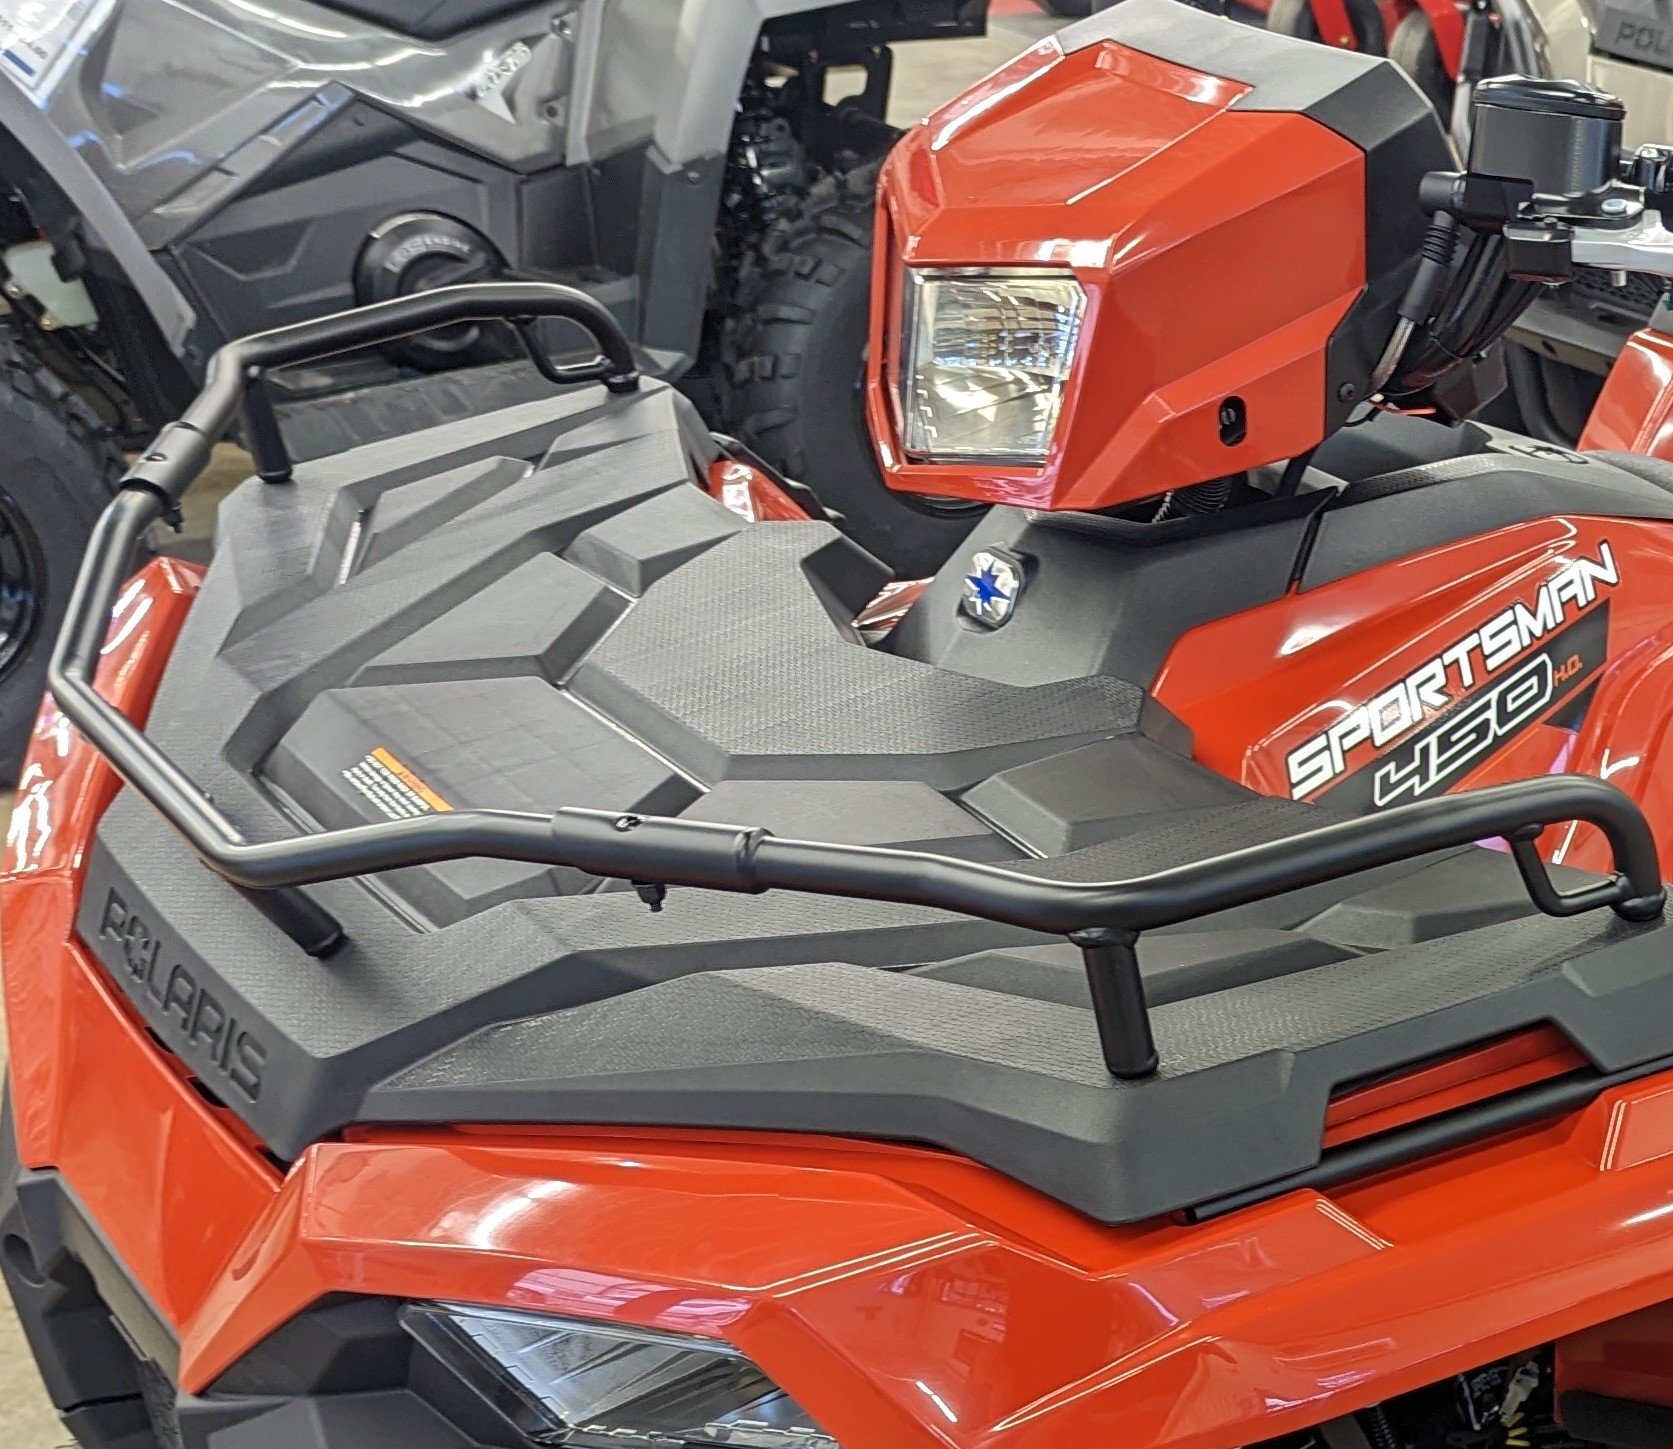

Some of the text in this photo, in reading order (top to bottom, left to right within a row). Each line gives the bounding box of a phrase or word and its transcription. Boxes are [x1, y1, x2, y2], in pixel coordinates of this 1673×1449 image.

[1287, 541, 1619, 801] SPORTSMAN
[1374, 653, 1552, 806] 450
[99, 887, 267, 1103] POLARIS
